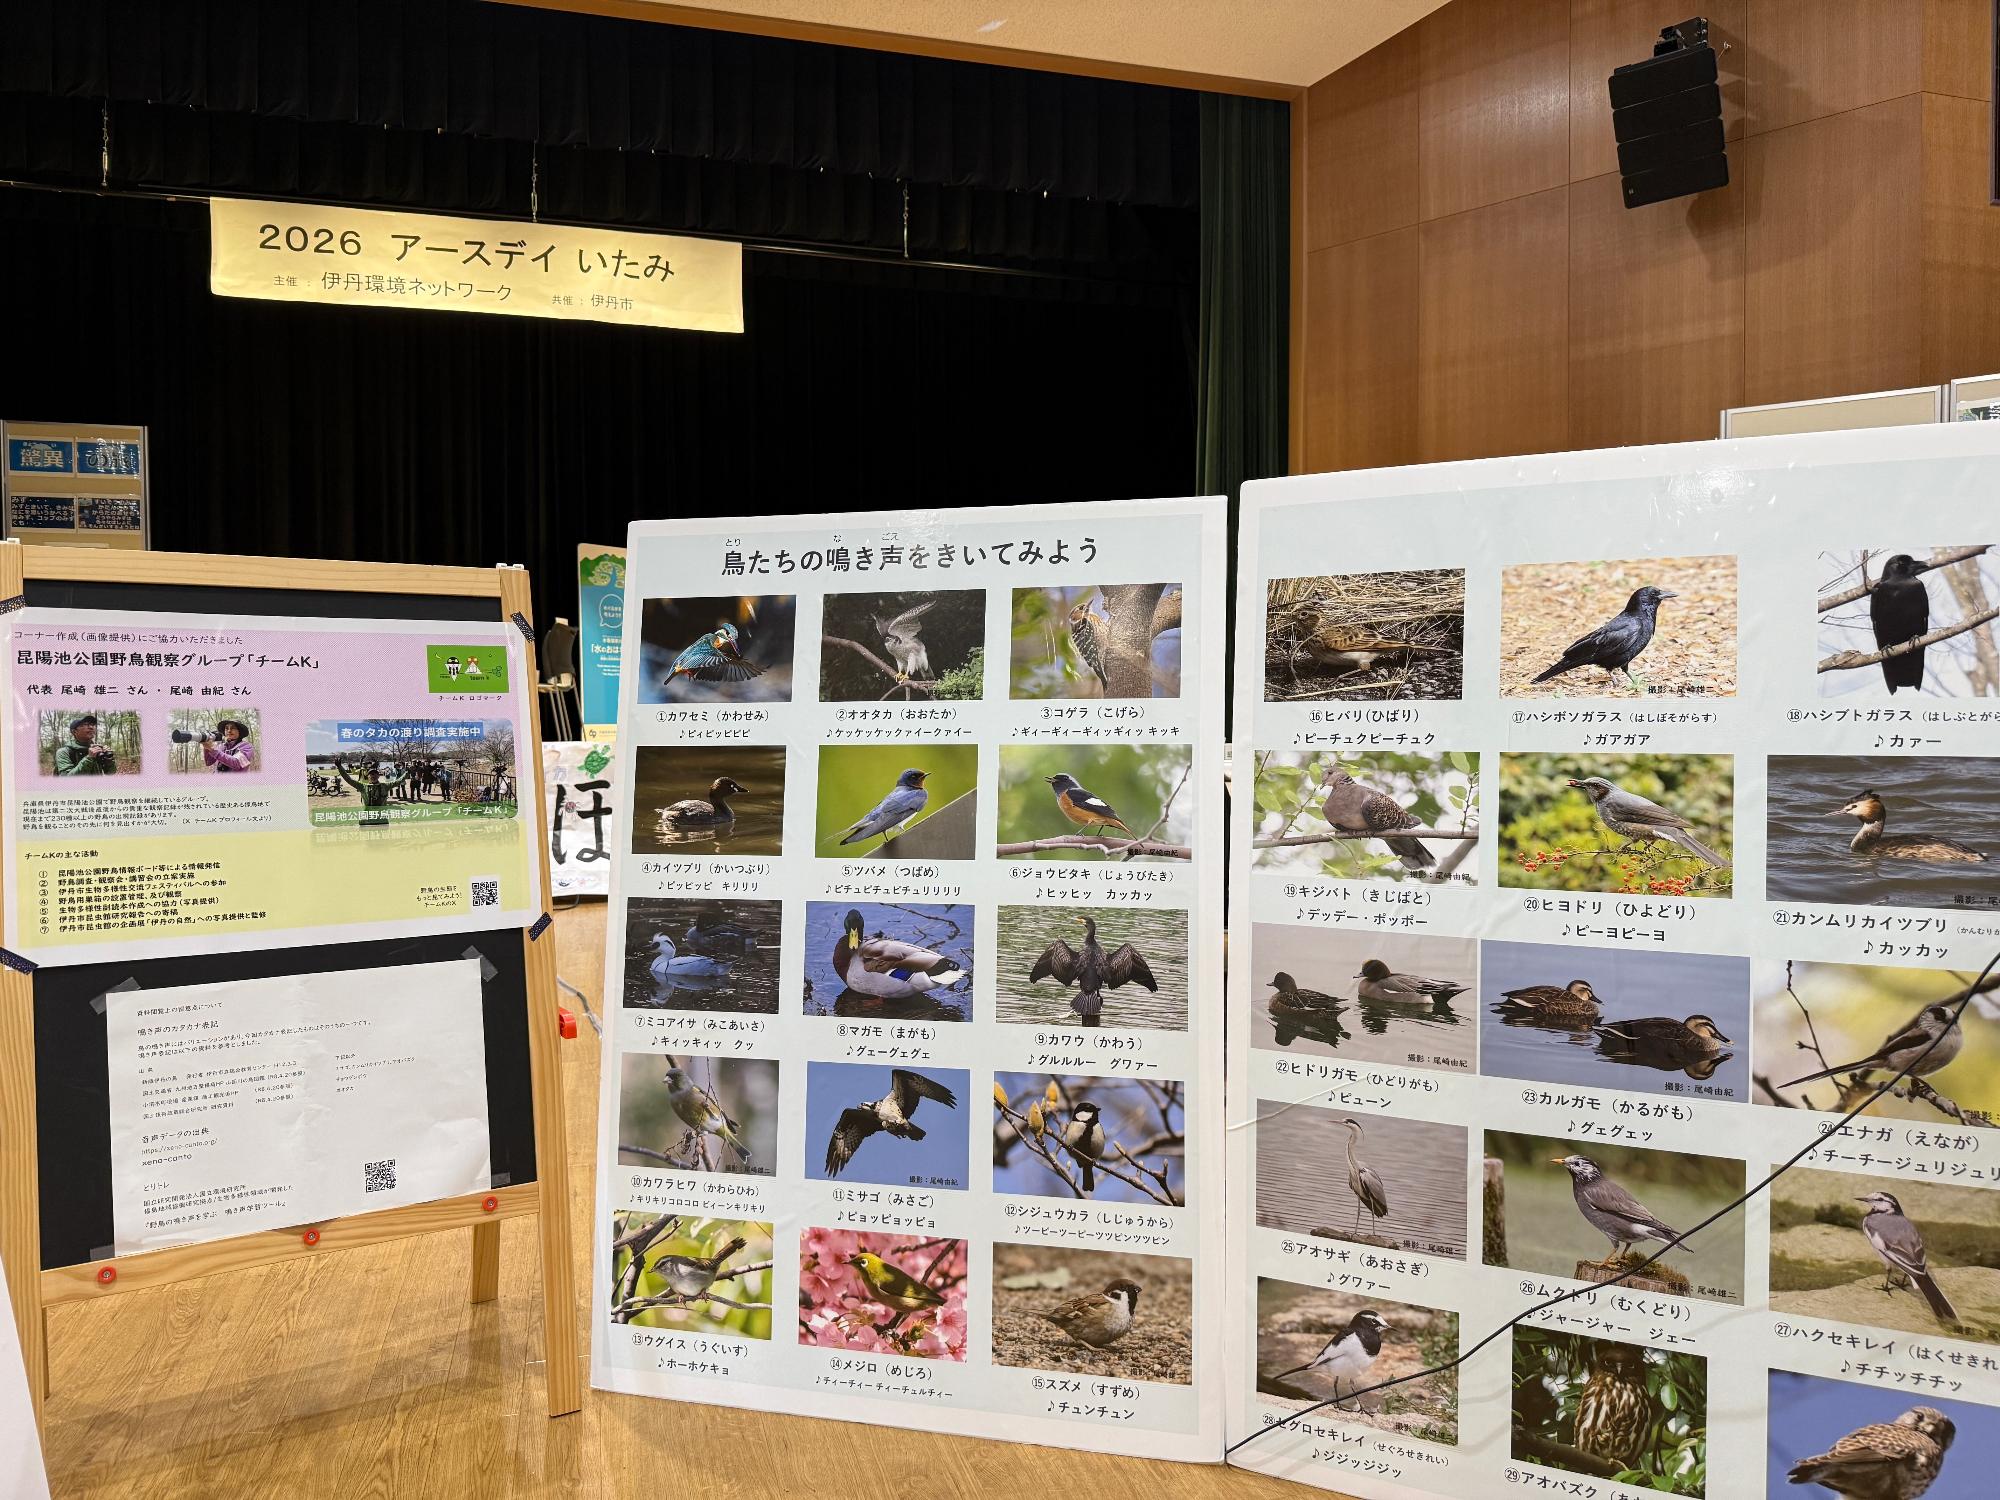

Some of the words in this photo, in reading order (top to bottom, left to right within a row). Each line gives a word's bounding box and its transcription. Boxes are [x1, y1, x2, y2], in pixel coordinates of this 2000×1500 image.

[258, 224, 363, 256] 2026
[390, 232, 558, 274] アースデイ
[577, 247, 676, 283] いたみ
[321, 271, 513, 302] 伊丹環境ネットワーク
[590, 293, 634, 312] 伊丹市
[725, 538, 741, 547] とり
[833, 534, 842, 543] な
[881, 532, 900, 541] ごえ
[721, 537, 1098, 577] 鳥たちの鳴き声をきいてみよう
[17, 650, 320, 669] 昆陽池公園野鳥観察グループ「チームK」
[27, 685, 52, 695] 代表
[61, 685, 86, 695] 尾崎
[93, 685, 119, 695] 雄二
[127, 686, 148, 696] さん
[170, 686, 193, 696] 尾崎
[201, 686, 225, 696] 由紀
[231, 686, 251, 696] さん
[340, 727, 482, 738] 春のタカの渡り調査実施中
[1148, 726, 1180, 736] キッキ
[1596, 734, 1651, 746] ガアガア
[1889, 734, 1942, 748] カァー
[551, 780, 613, 866] ほ
[25, 849, 99, 860] チームKの主な活動
[1047, 888, 1092, 900] ヒッヒッ
[1106, 888, 1153, 901] カッカッ
[1954, 893, 2000, 907] 撮影：尾
[1576, 923, 1666, 942] ピーヨピーヨ
[1879, 941, 1949, 959] カッカッ
[734, 1040, 754, 1051] クッ
[1038, 1054, 1097, 1067] グルルルー
[1110, 1057, 1158, 1072] グワァー
[1407, 1053, 1468, 1068] 撮影：尾崎由紀
[1664, 1081, 1734, 1097] 撮影：尾崎由紀
[1338, 1273, 1391, 1291] グワァー
[1540, 1308, 1631, 1333] ジャージャー
[1649, 1327, 1696, 1345] ジェー
[667, 1358, 730, 1376] ホーホケキョ
[1855, 1362, 1963, 1392] チチッチチッ
[1059, 1401, 1135, 1421] チュンチュン
